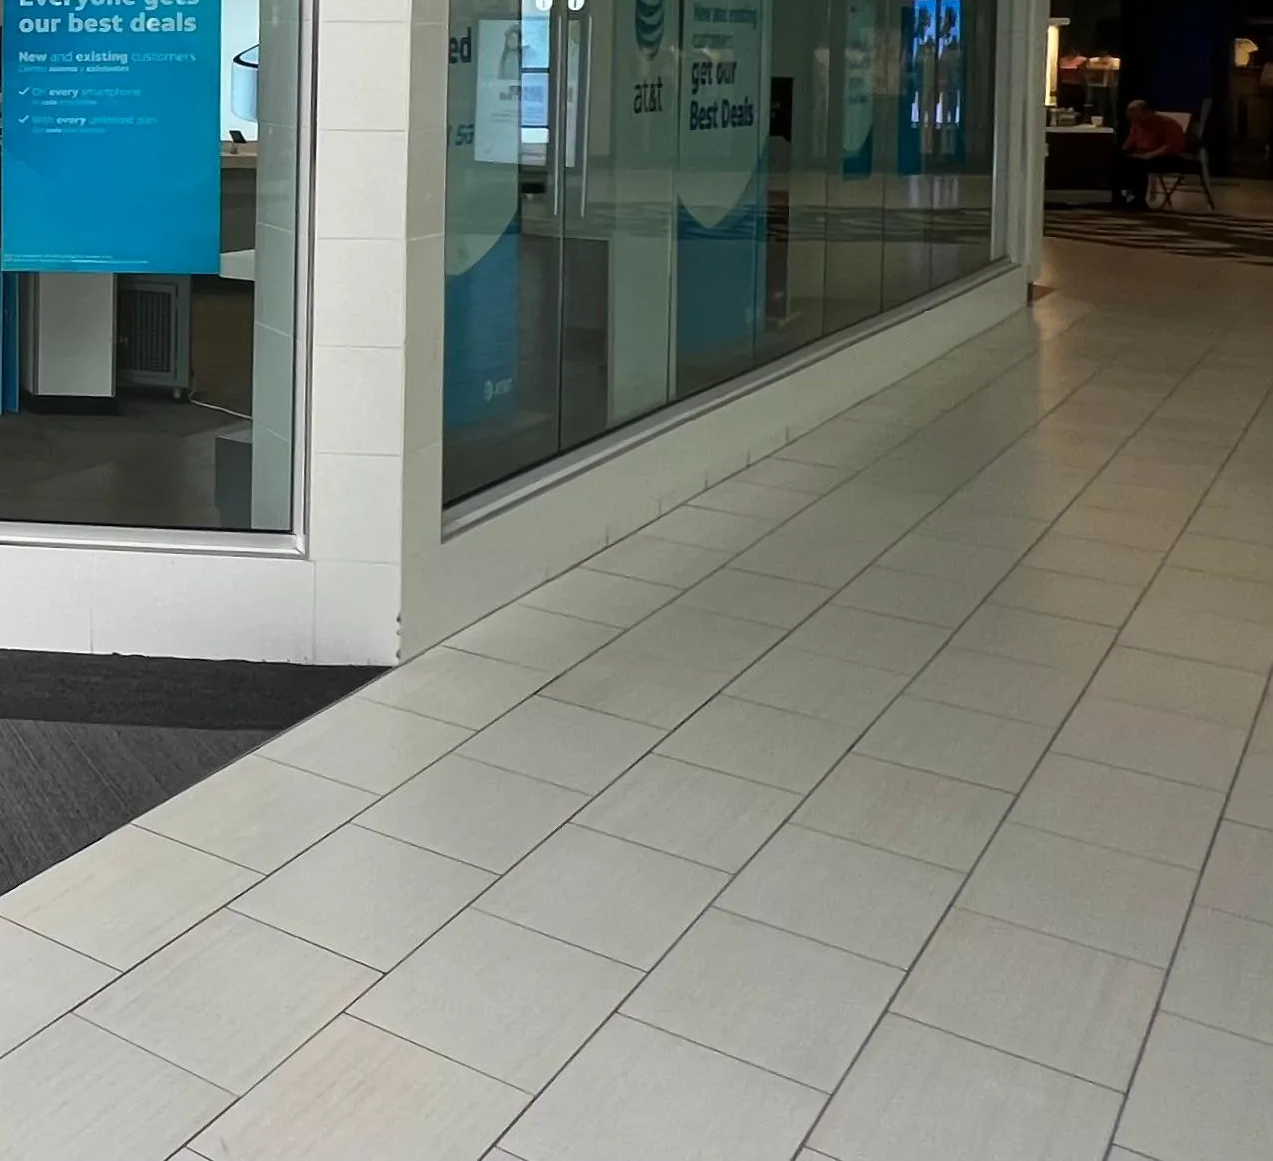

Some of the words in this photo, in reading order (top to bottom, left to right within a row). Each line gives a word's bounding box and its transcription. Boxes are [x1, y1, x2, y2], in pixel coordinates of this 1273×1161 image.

[18, 16, 62, 33] our
[68, 12, 124, 33] best
[129, 11, 198, 33] deals
[18, 50, 48, 63] New
[50, 50, 74, 63] and
[75, 50, 129, 65] existing
[131, 51, 197, 63] customers
[448, 26, 472, 65] ed
[691, 61, 714, 95] get
[716, 61, 737, 86] our
[49, 88, 80, 99] every
[633, 75, 663, 115] at&t
[56, 116, 87, 127] every
[689, 100, 718, 131] Best
[721, 95, 754, 129] Deals
